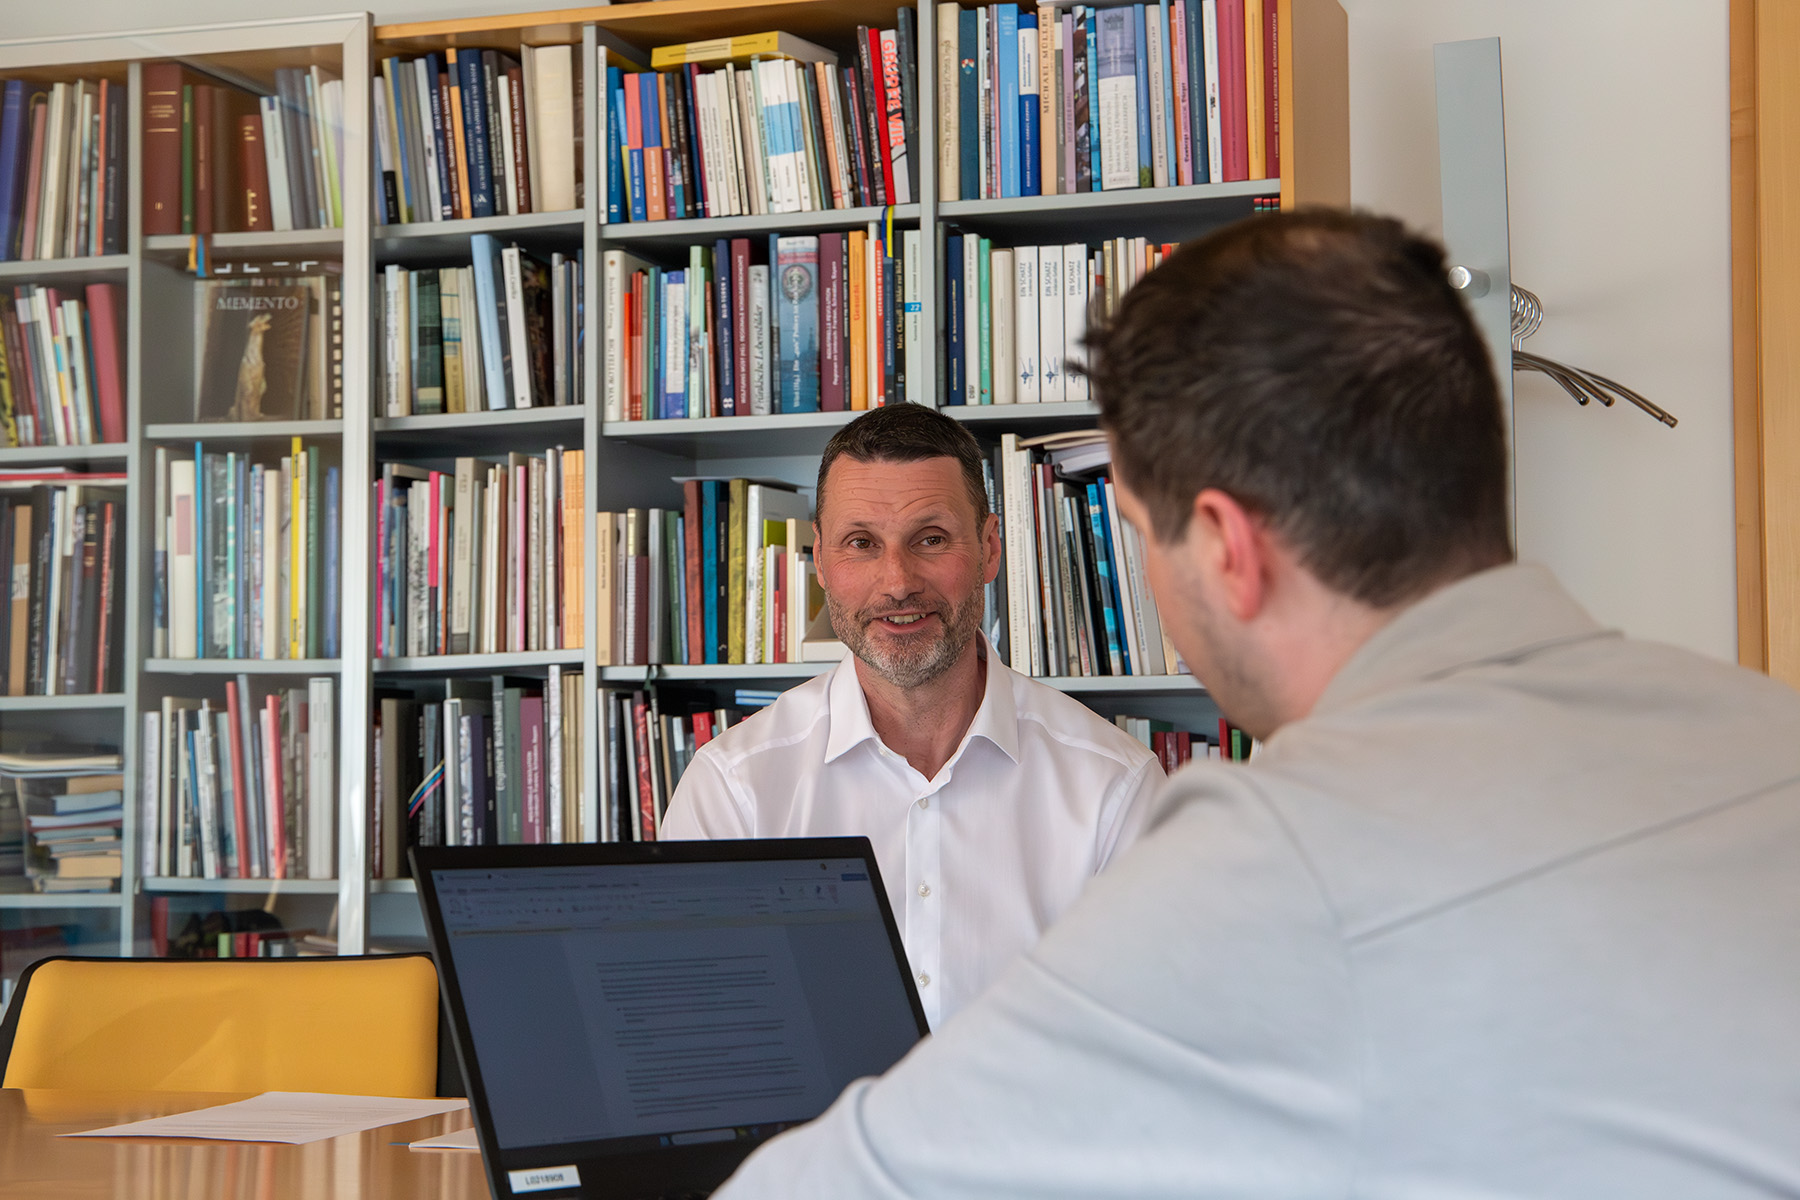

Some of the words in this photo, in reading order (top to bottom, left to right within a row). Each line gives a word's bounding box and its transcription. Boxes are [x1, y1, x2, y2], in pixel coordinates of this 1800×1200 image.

[1041, 13, 1049, 58] MÜLLER
[882, 39, 901, 111] GRUPPE
[887, 111, 905, 147] WIR
[1019, 262, 1027, 285] SCHATZ
[216, 296, 299, 310] MEMENTO
[895, 286, 903, 303] Bilder
[1019, 286, 1027, 297] EIN
[753, 304, 764, 360] Lebensbilder
[896, 309, 904, 333] Chagall
[607, 338, 615, 352] BIG
[607, 354, 615, 384] FELLOW
[607, 386, 615, 406] MAN
[754, 361, 765, 410] Fränkische
[494, 701, 504, 747] Buchkunst
[495, 748, 506, 791] Englische
